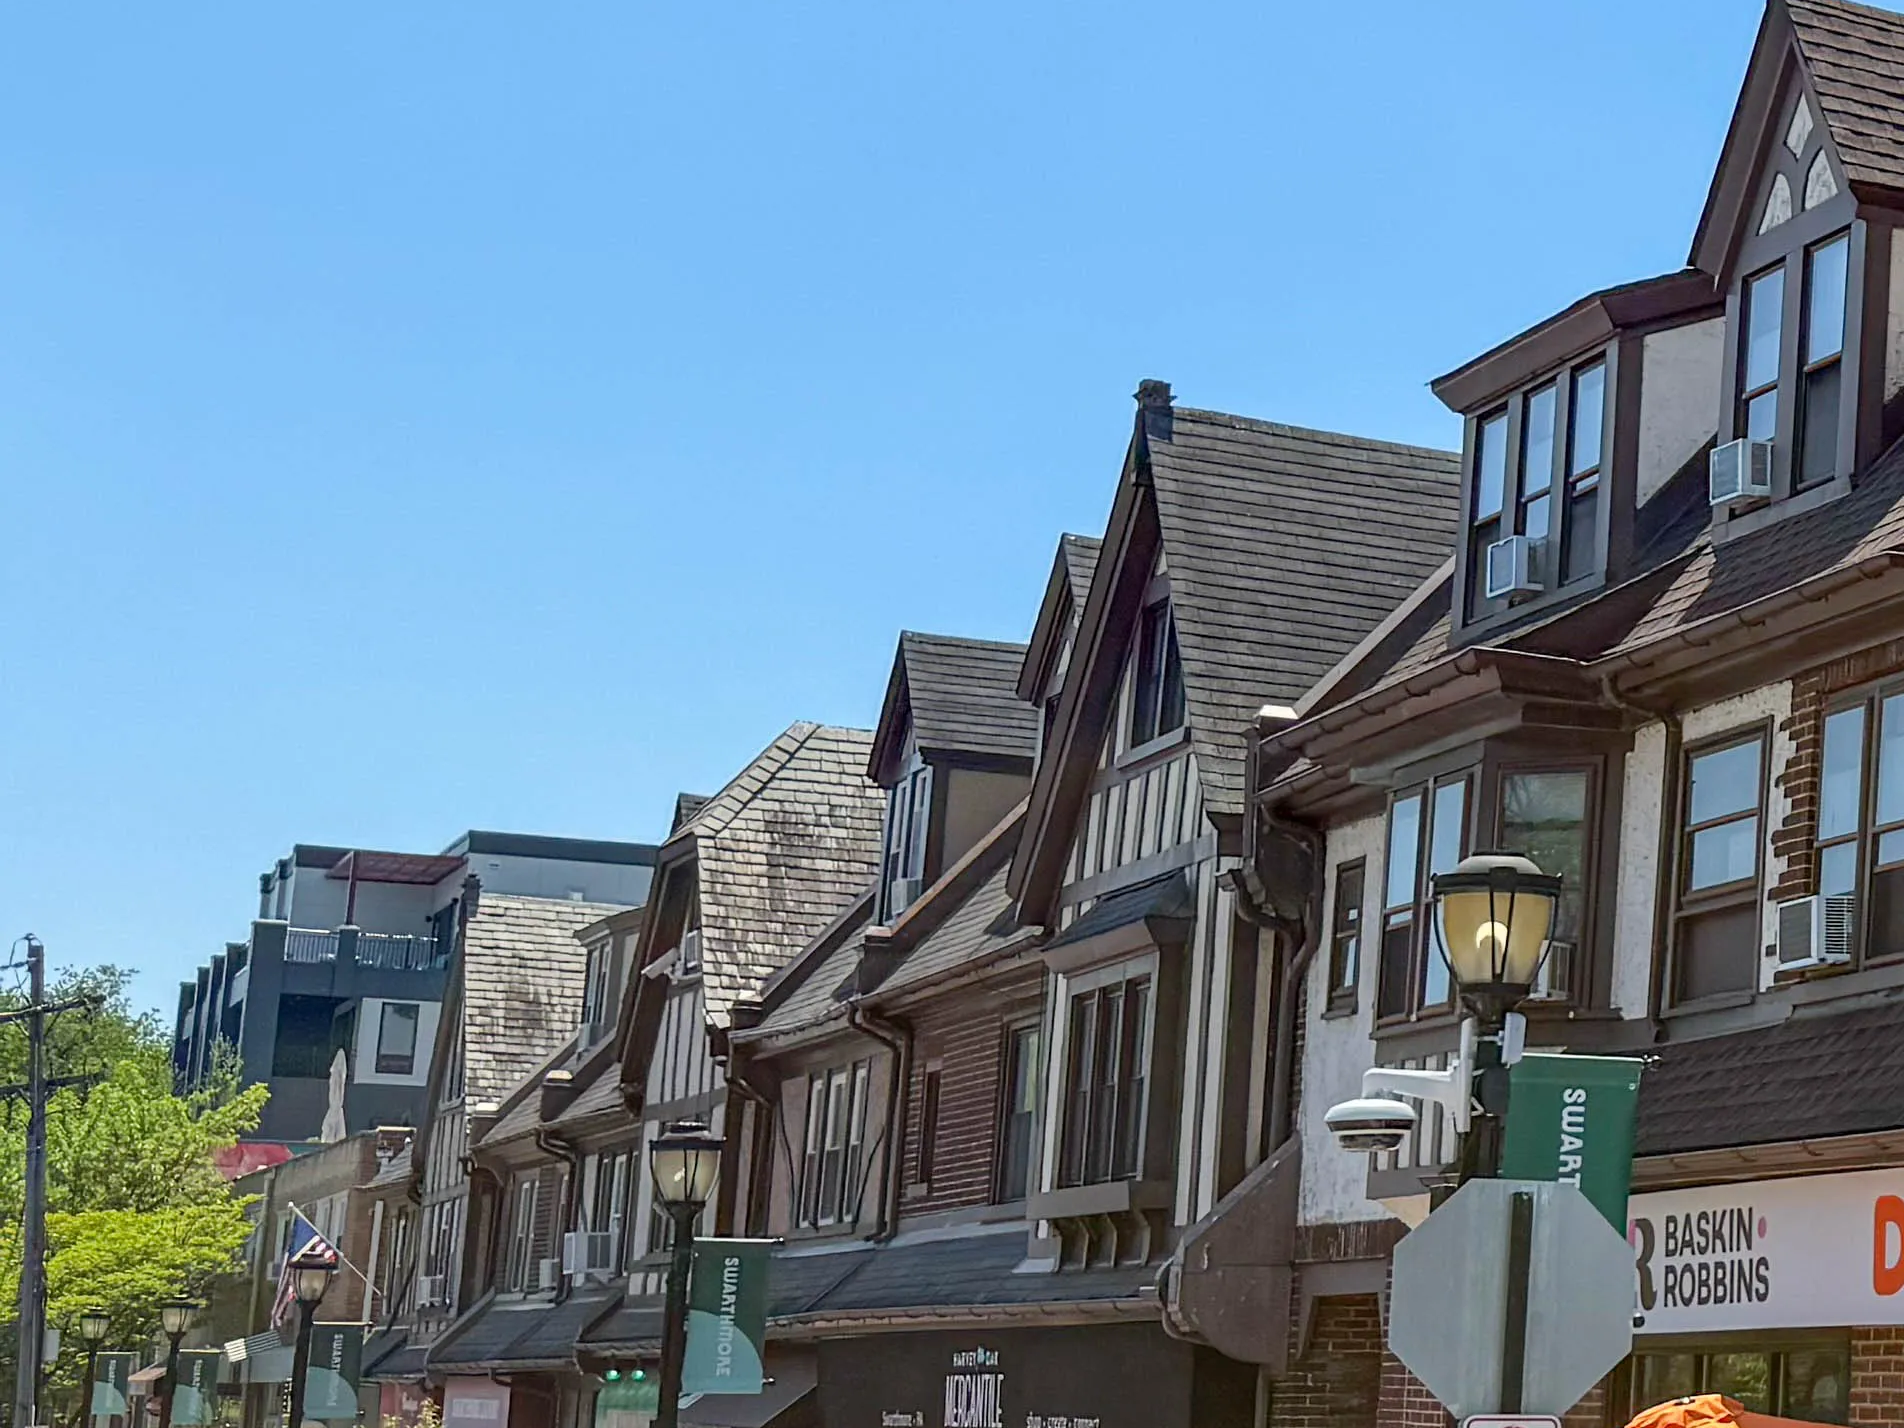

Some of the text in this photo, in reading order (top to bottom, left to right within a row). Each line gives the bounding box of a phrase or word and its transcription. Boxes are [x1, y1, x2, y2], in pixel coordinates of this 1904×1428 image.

[1664, 1206, 1753, 1257] BASKIN
[1663, 1256, 1770, 1308] ROBBINS
[715, 1256, 740, 1377] SWARTHMORE
[943, 1374, 1005, 1428] MERCANTILE
